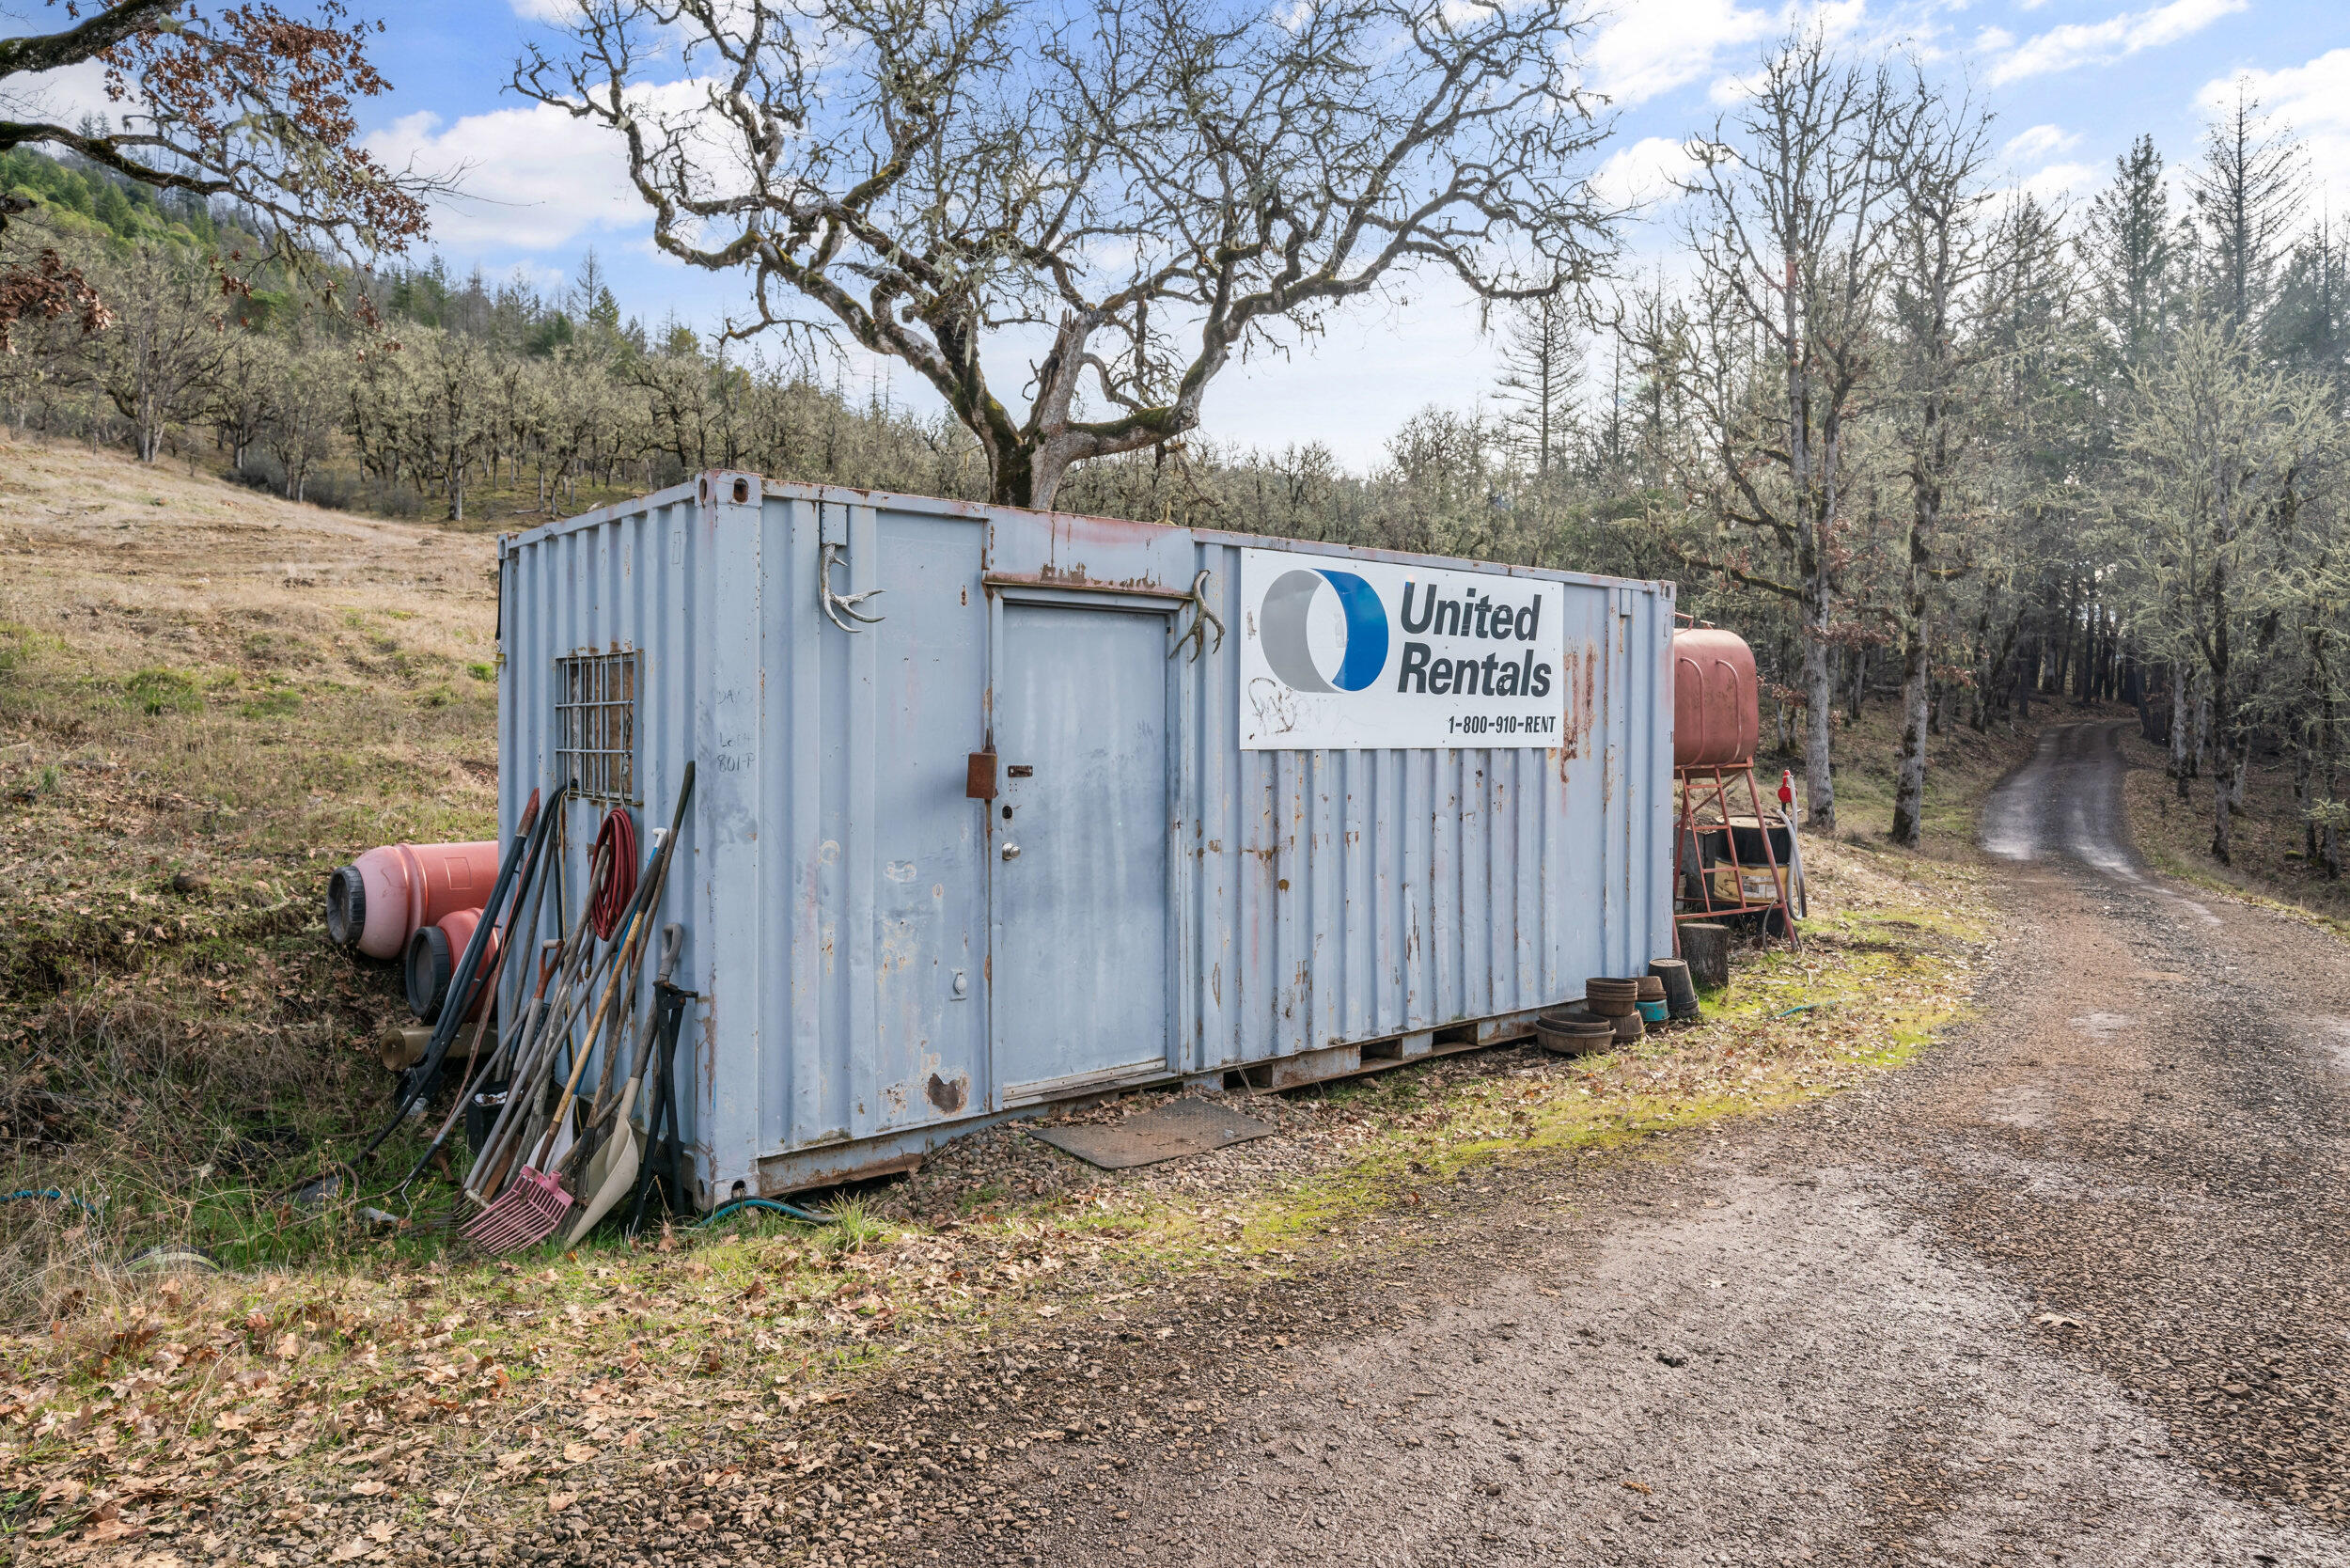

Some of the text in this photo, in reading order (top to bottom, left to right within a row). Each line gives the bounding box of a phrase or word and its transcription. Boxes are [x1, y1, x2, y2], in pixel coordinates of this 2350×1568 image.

[1401, 581, 1542, 641] United
[1397, 641, 1552, 698] Rentals
[1449, 715, 1557, 734] 1-800-910-RENT
